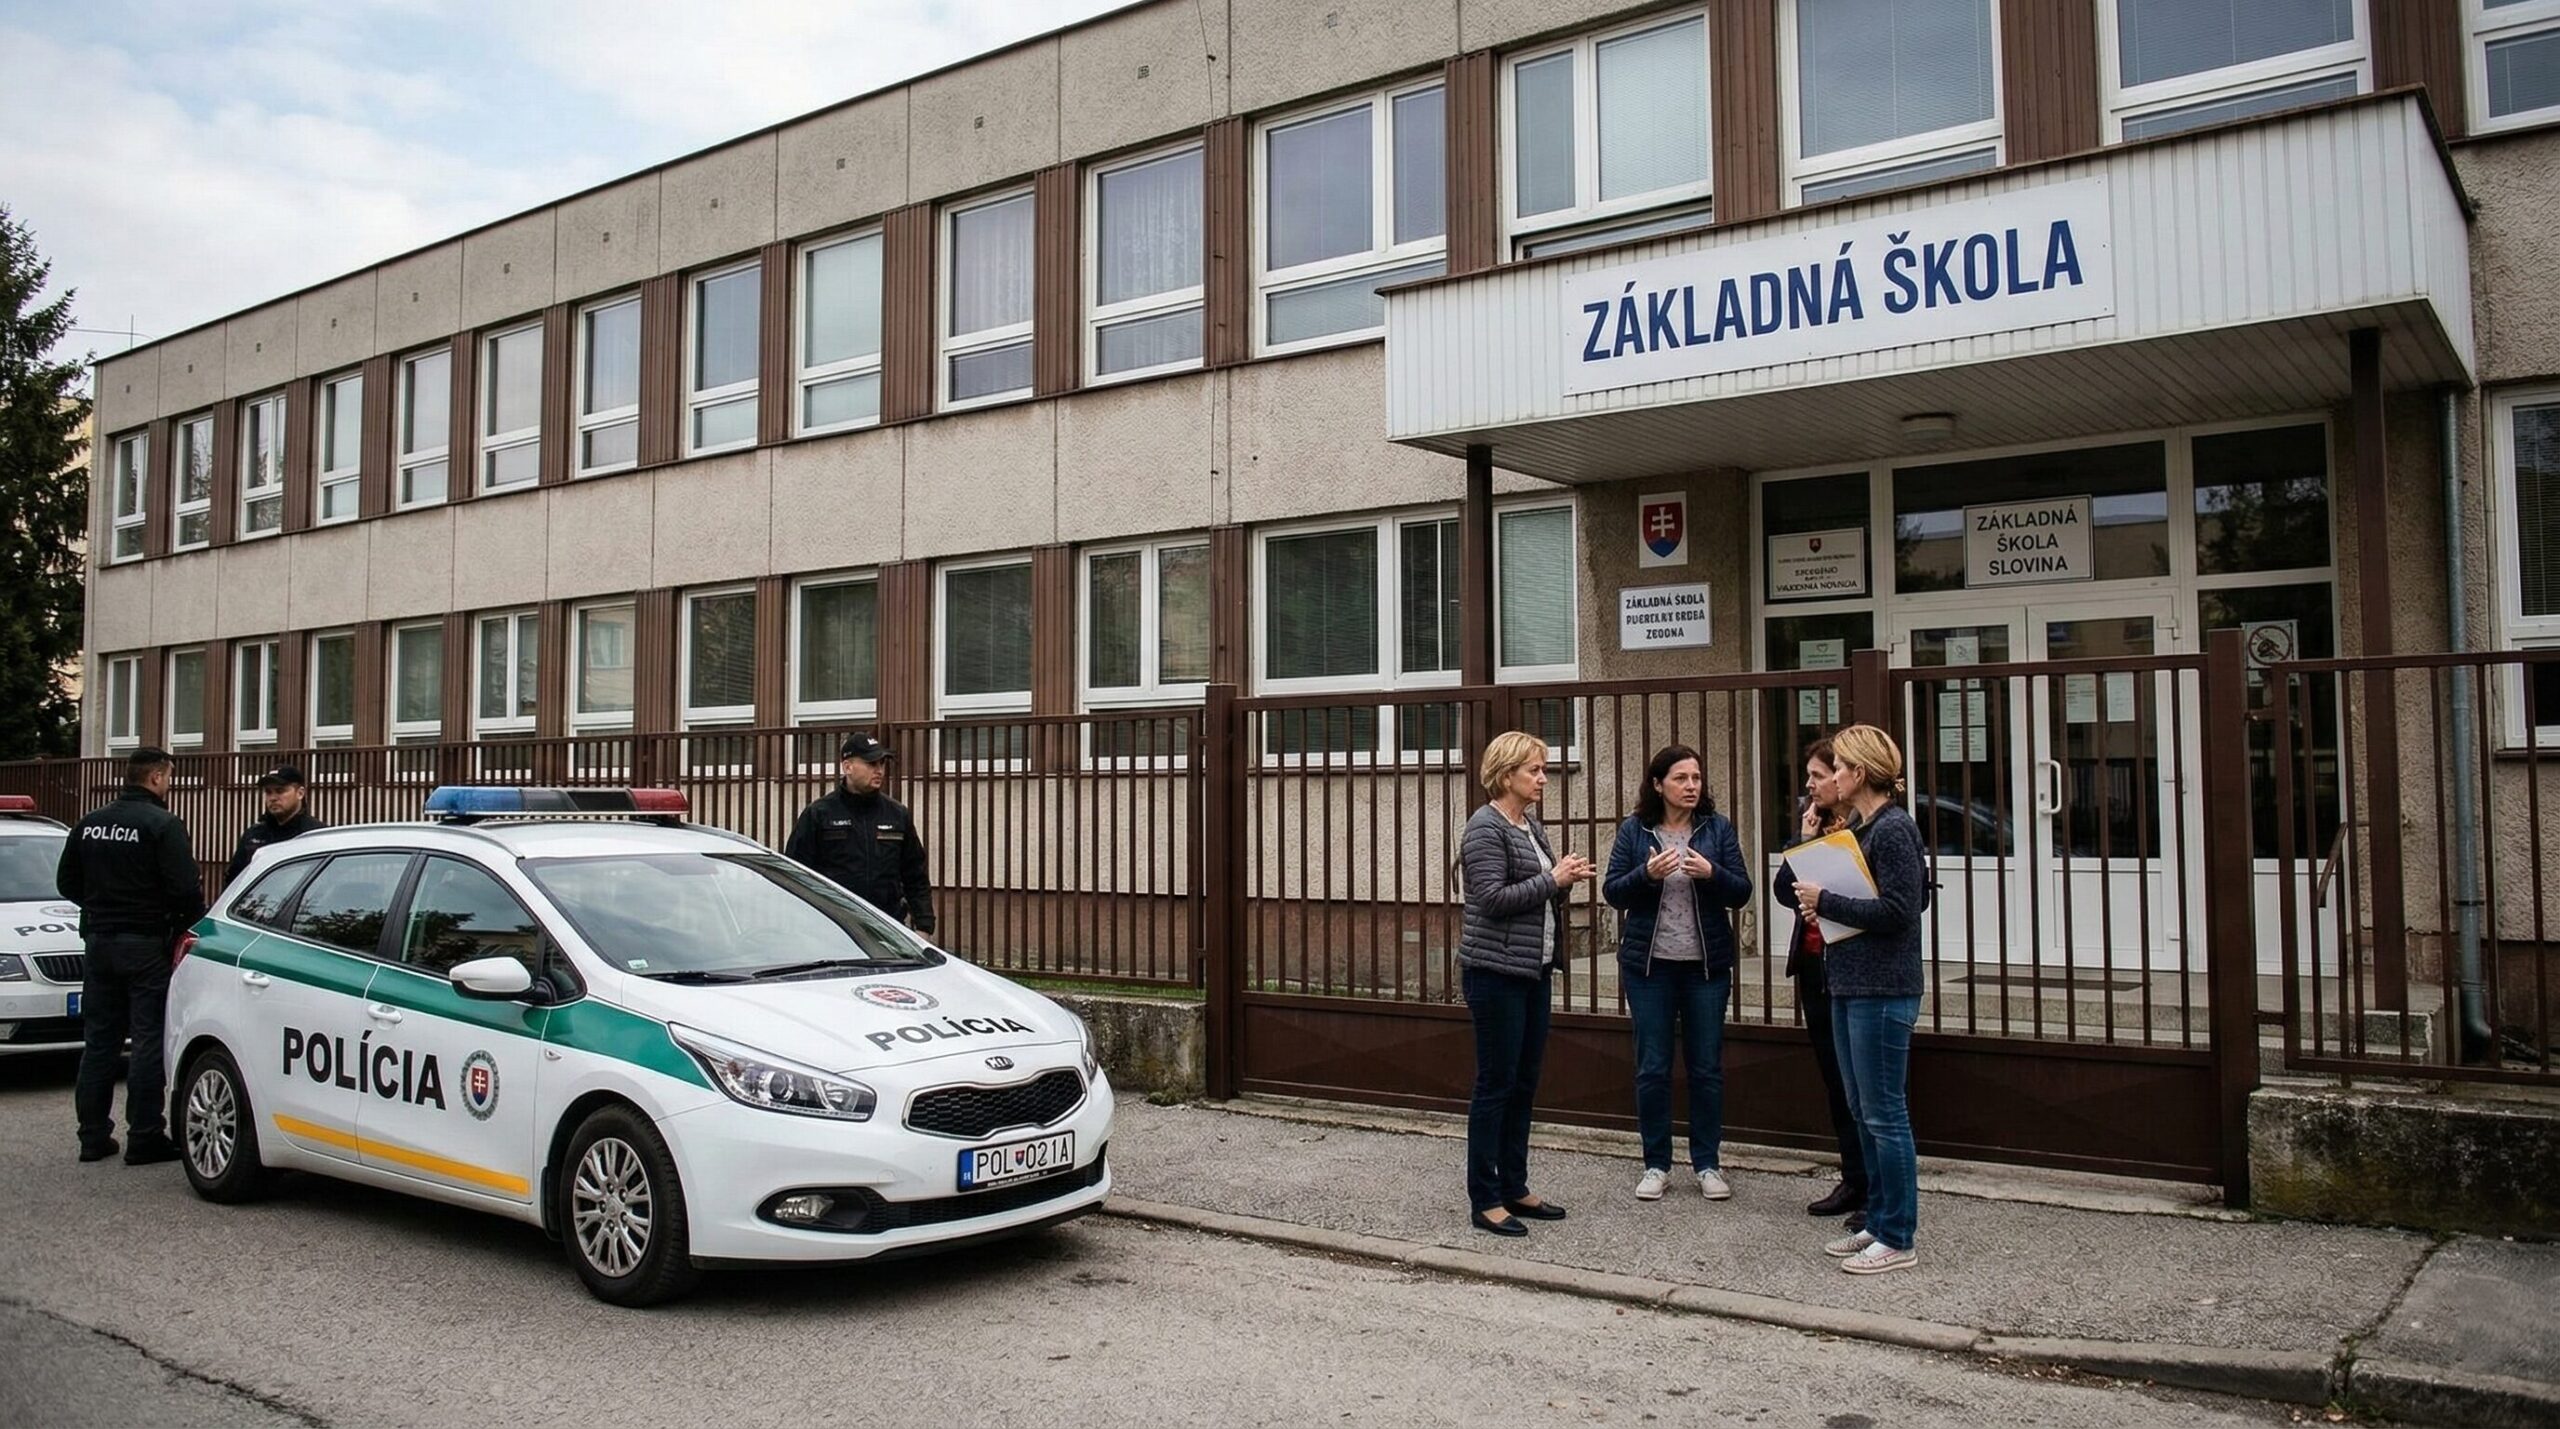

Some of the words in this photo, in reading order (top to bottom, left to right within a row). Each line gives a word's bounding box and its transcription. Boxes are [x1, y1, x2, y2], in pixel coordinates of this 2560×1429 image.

[1583, 241, 1864, 362] ZÁKLADNÁ
[1883, 220, 2083, 313] ŠKOLA
[1976, 504, 2078, 531] ZÁKLADNÁ
[1997, 533, 2059, 552] ŠKOLA
[1989, 556, 2068, 576] SLOVINA
[82, 824, 139, 843] POLÍCIA
[283, 1027, 447, 1111] POLÍCIA
[976, 1148, 1014, 1179] POL
[1026, 1137, 1069, 1169] 021A
